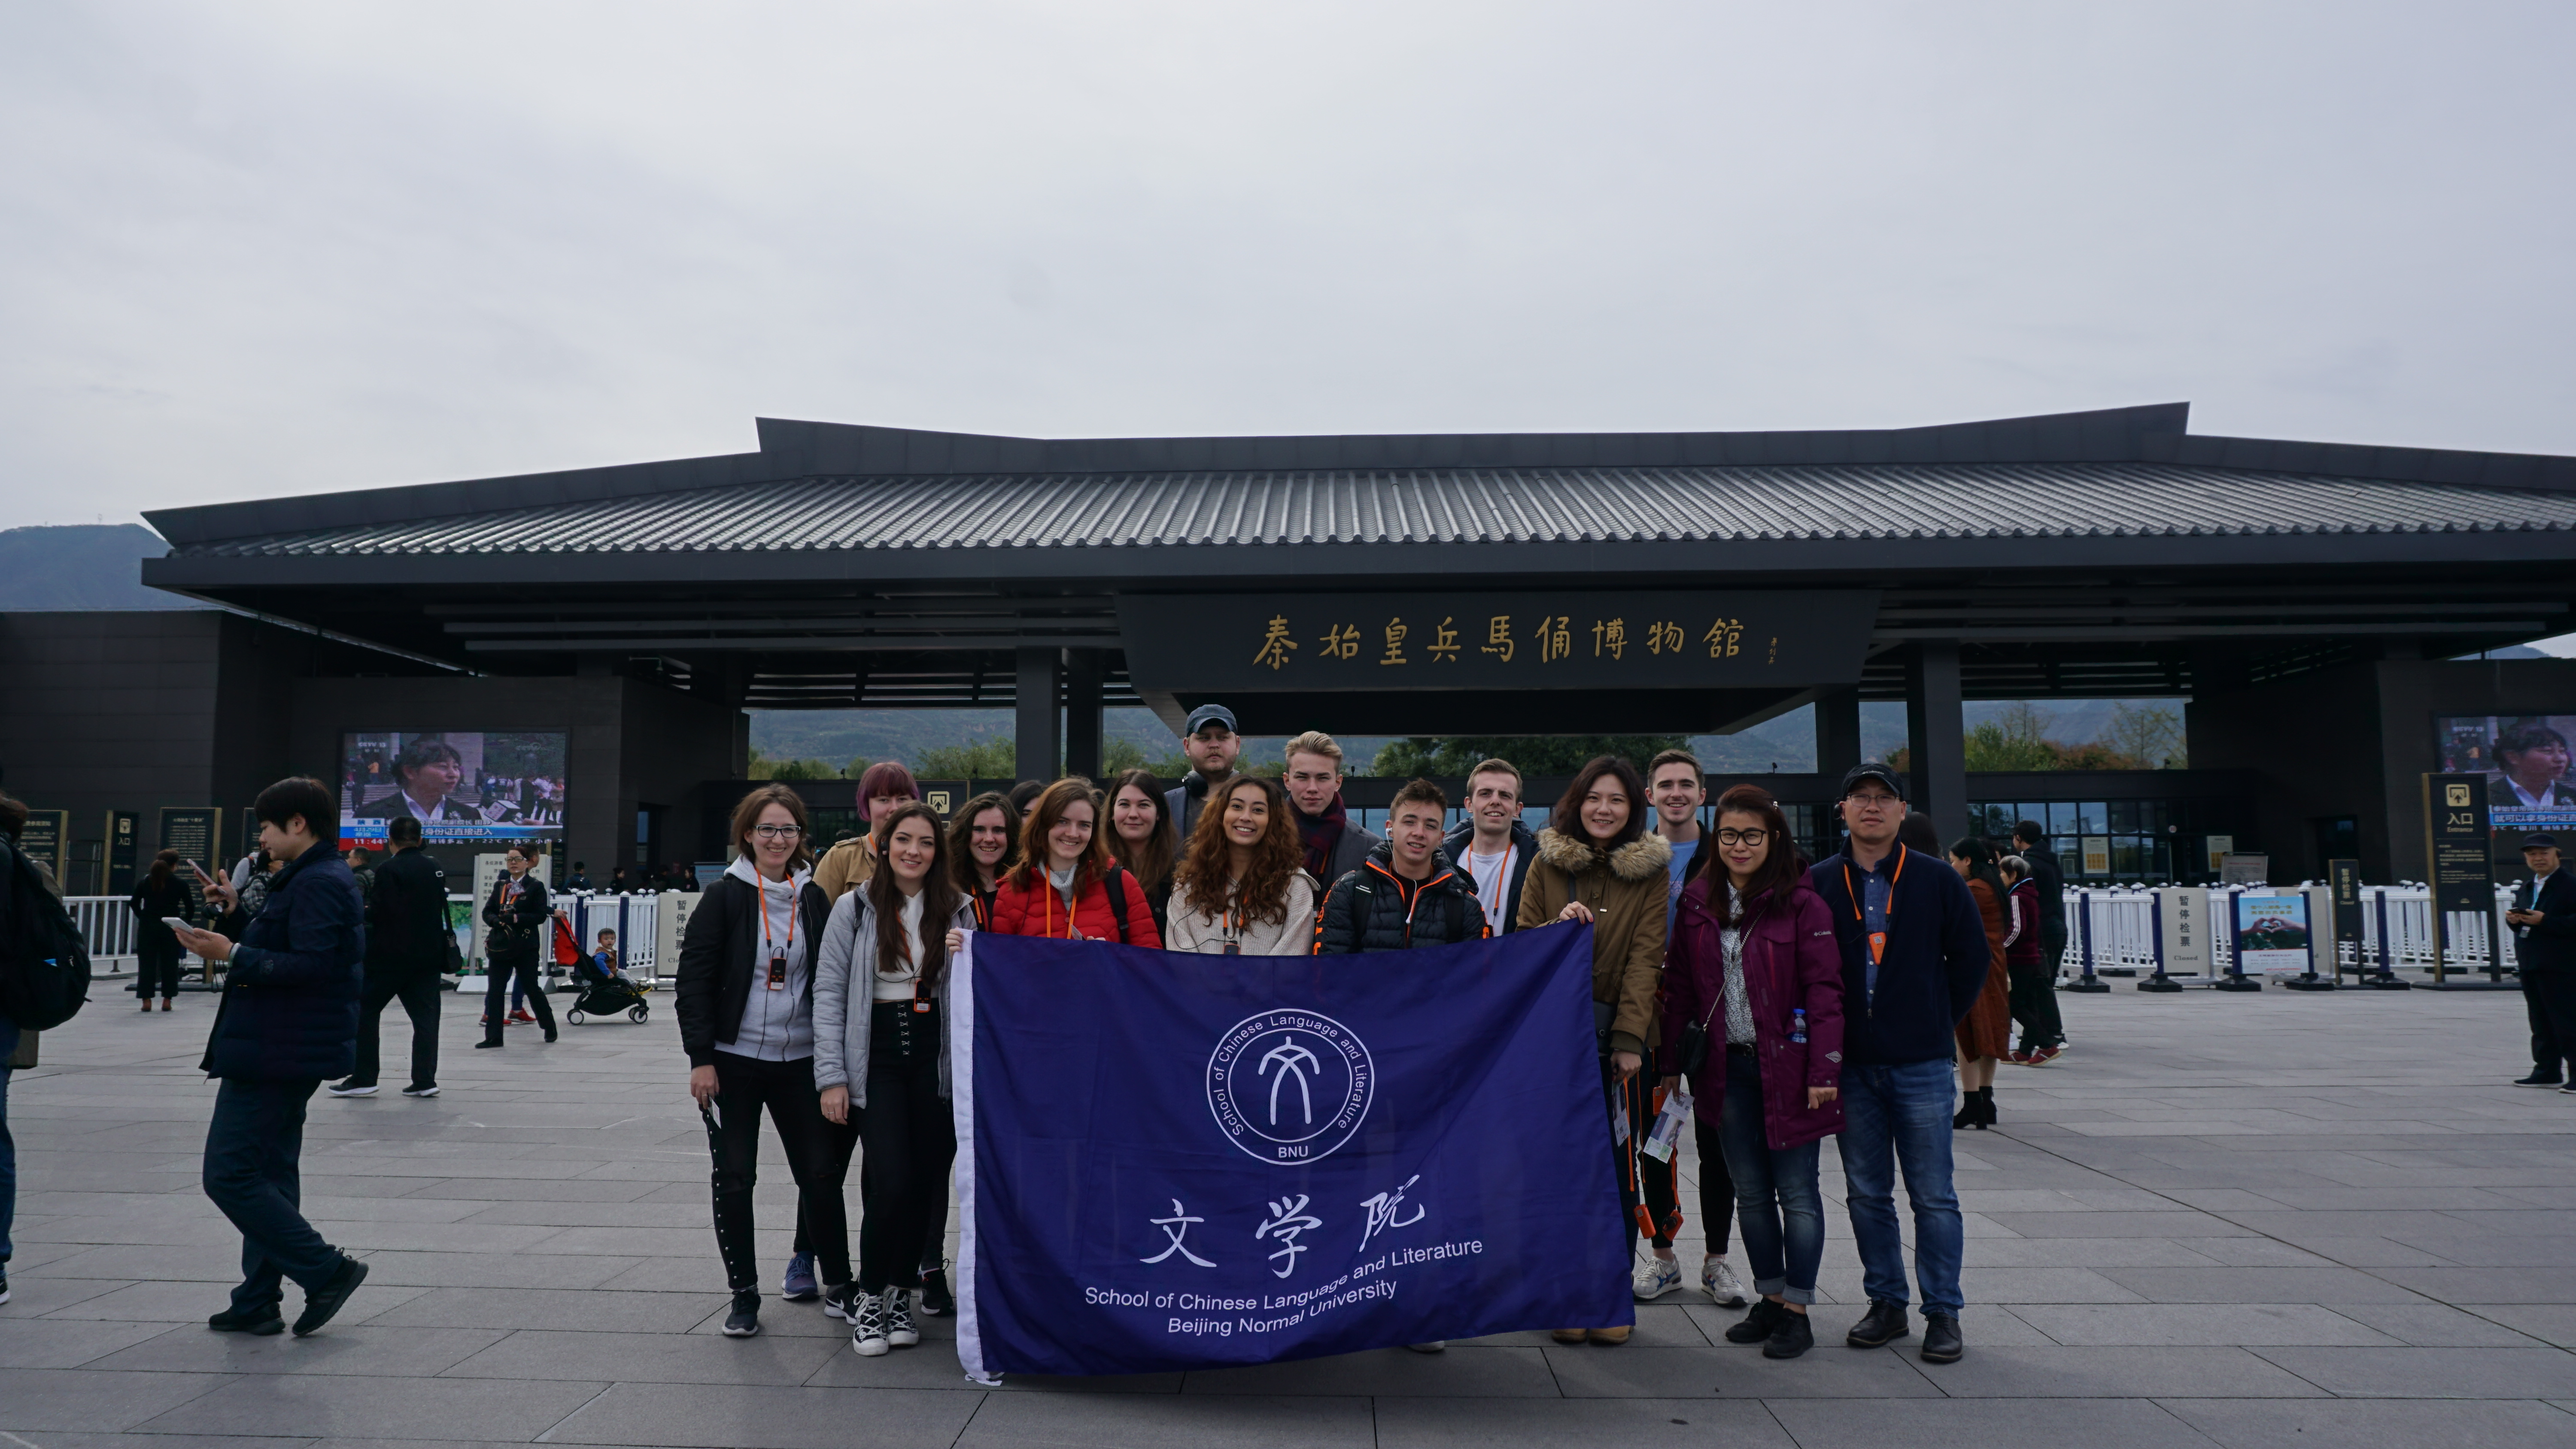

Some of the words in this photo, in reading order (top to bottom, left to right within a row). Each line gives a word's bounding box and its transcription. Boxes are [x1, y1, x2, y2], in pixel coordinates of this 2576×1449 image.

[1252, 614, 1744, 670] 秦始皇兵馬俑博物館
[117, 837, 131, 846] 入口
[2447, 812, 2473, 825] 入口
[675, 900, 687, 950] 暂停检票
[2178, 895, 2190, 947] 暂停检票
[1218, 1022, 1263, 1062] Chinese
[1270, 1016, 1338, 1037] Language
[1340, 1039, 1361, 1060] and
[1214, 1066, 1225, 1081] of
[1338, 1064, 1367, 1129] Literature
[1213, 1088, 1244, 1136] School
[1278, 1145, 1309, 1158] BNU
[1139, 1174, 1425, 1279] 文学院
[1085, 1287, 1149, 1307] School
[1155, 1293, 1175, 1309] of
[1179, 1294, 1257, 1310] Chinese
[1264, 1274, 1348, 1310] Language
[1353, 1256, 1385, 1279] and
[1391, 1240, 1483, 1267] Literature
[1168, 1318, 1232, 1337] Beijing
[1239, 1310, 1305, 1333] Normal
[1309, 1280, 1397, 1317] University
